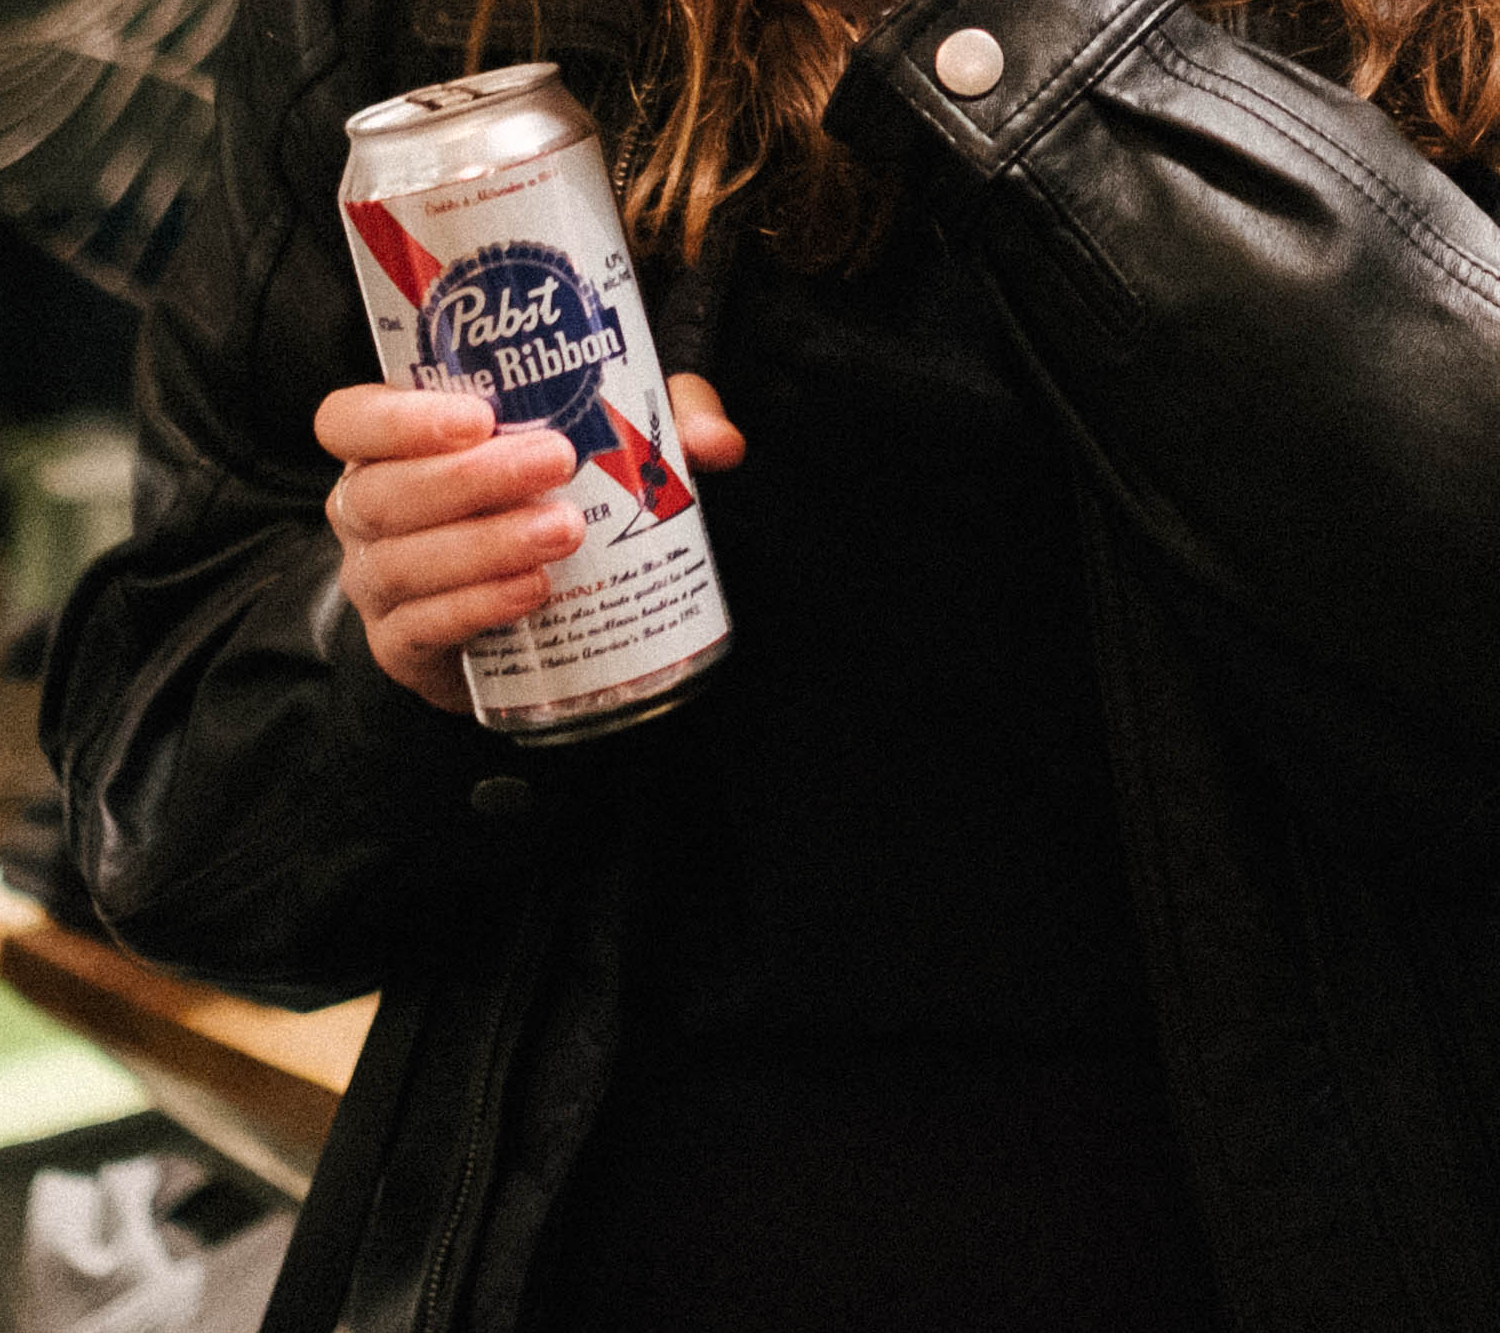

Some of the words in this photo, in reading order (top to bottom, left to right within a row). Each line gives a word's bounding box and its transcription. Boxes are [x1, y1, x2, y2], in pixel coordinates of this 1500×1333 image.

[430, 275, 562, 352] Pabst
[495, 326, 622, 392] Ribbon
[583, 503, 612, 526] EER
